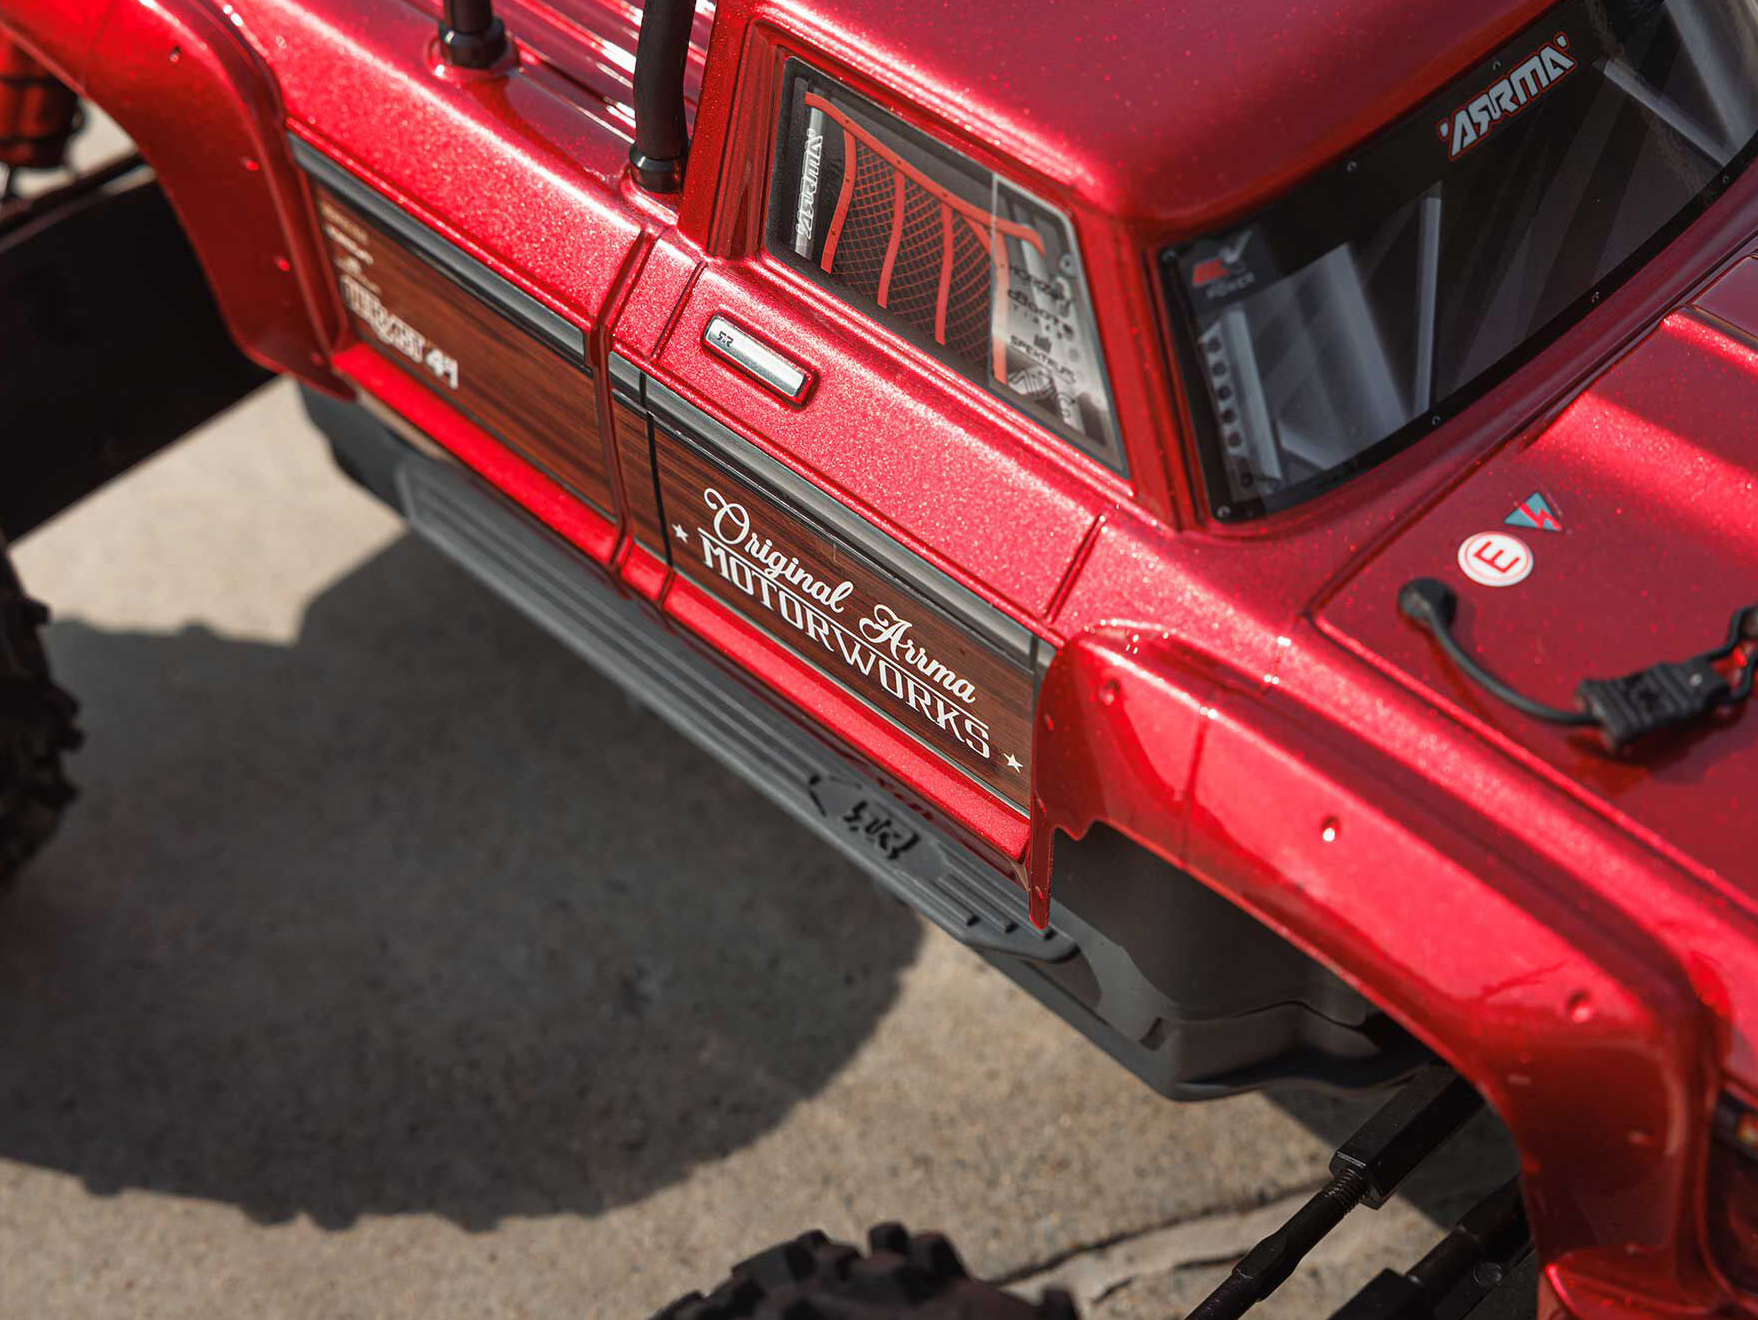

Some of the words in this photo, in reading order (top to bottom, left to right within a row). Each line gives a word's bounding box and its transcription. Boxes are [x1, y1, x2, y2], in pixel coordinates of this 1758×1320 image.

[701, 536, 991, 759] MOTORWORKS
[704, 488, 854, 613] Original
[859, 604, 977, 705] Arrma
